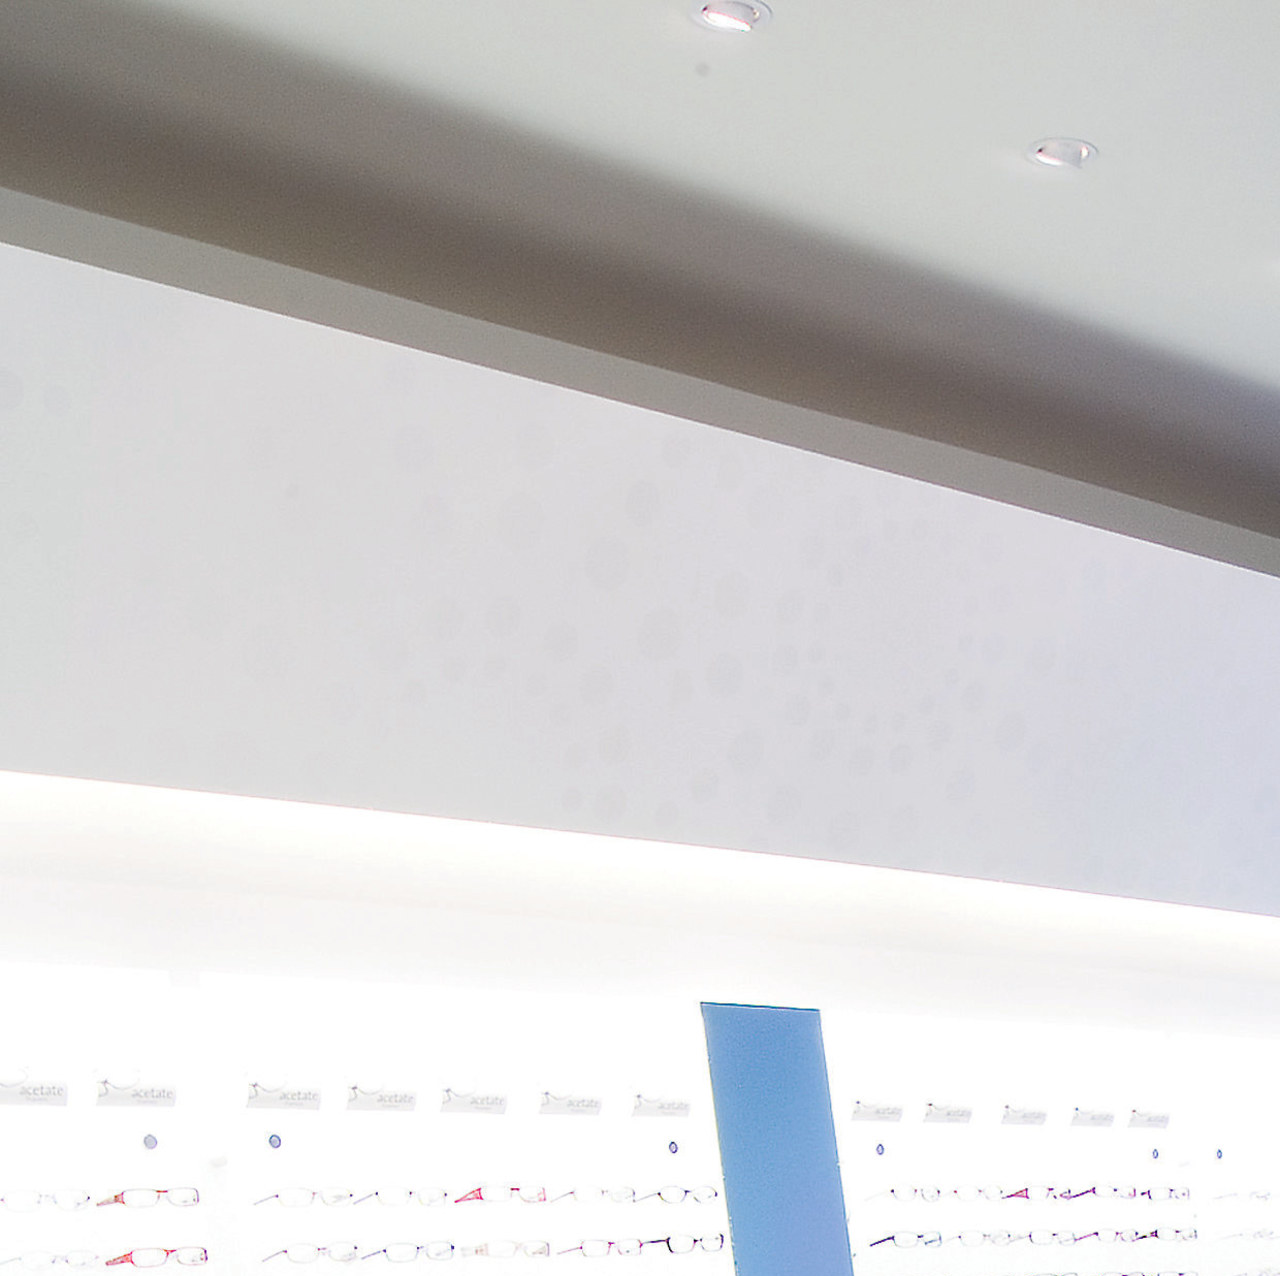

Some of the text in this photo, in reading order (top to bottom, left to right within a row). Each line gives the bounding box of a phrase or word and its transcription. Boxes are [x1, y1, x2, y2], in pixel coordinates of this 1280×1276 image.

[19, 1085, 64, 1097] acetate
[131, 1088, 174, 1099] acetate
[279, 1091, 319, 1101] acetate
[376, 1093, 414, 1104] acetate
